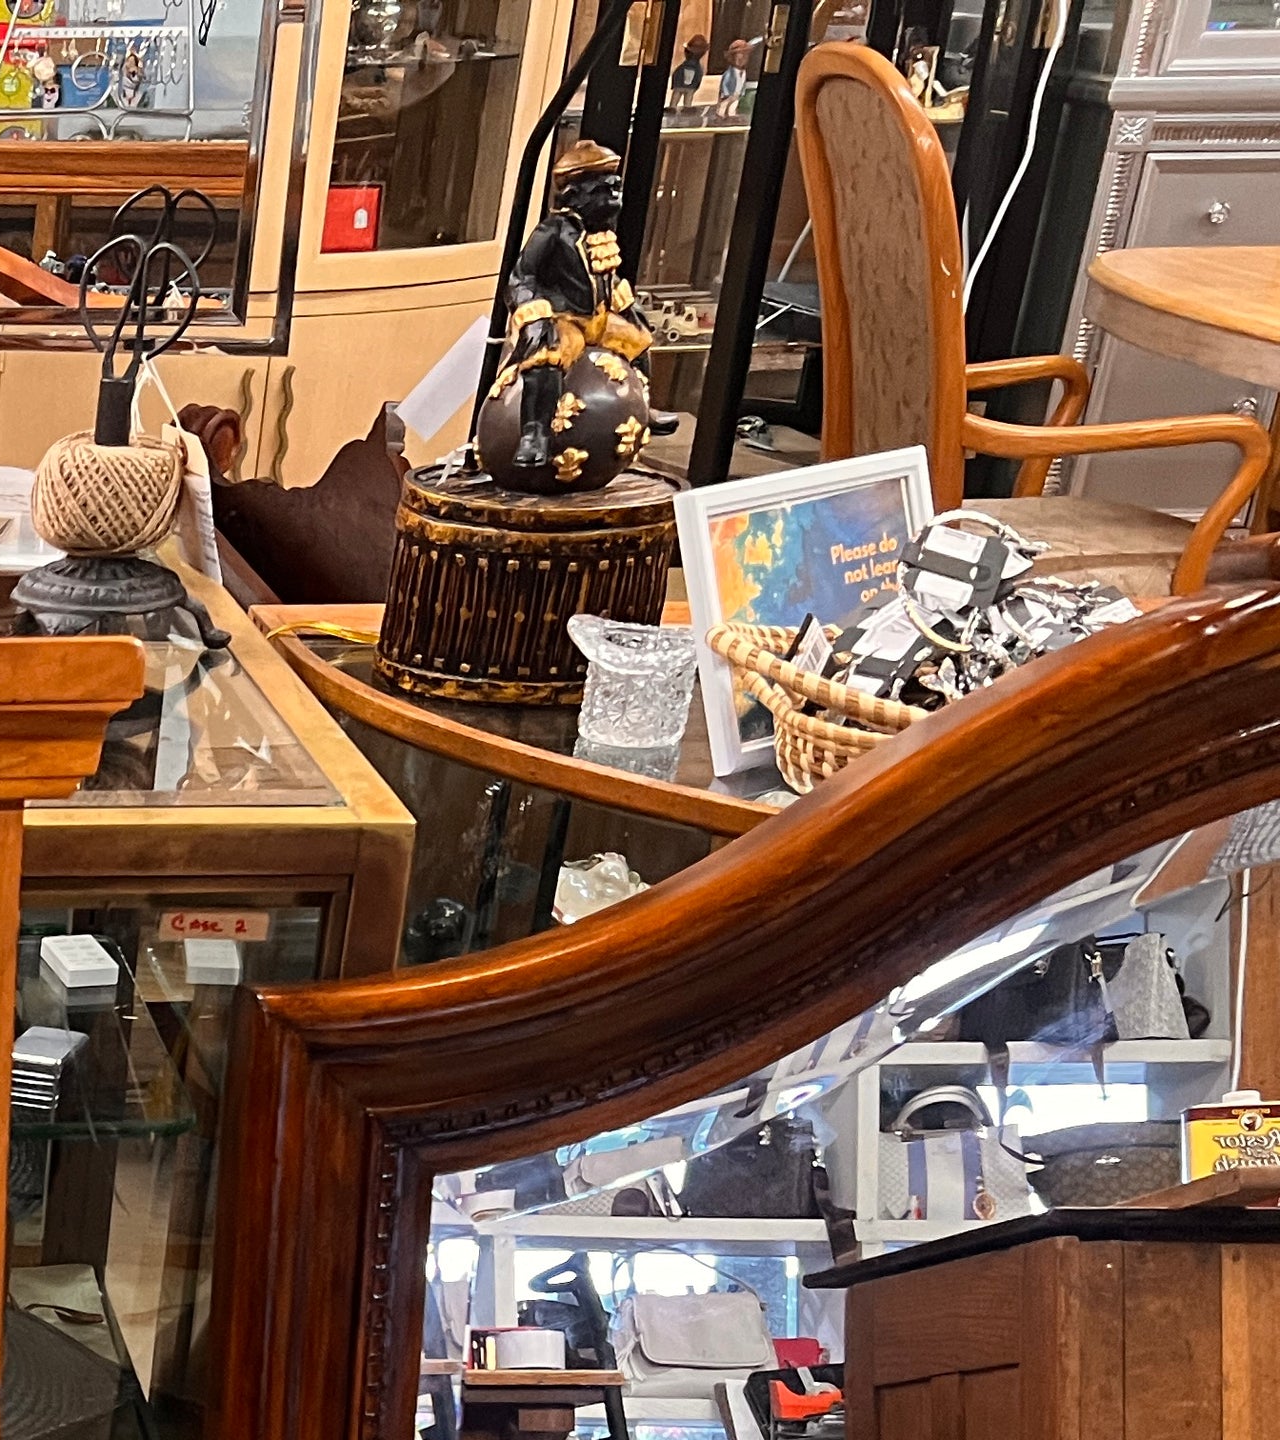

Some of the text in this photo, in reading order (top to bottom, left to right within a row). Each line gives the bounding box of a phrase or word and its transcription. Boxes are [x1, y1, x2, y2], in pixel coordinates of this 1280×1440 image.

[831, 532, 898, 564] Please do
[845, 564, 868, 584] not
[235, 919, 247, 934] 2
